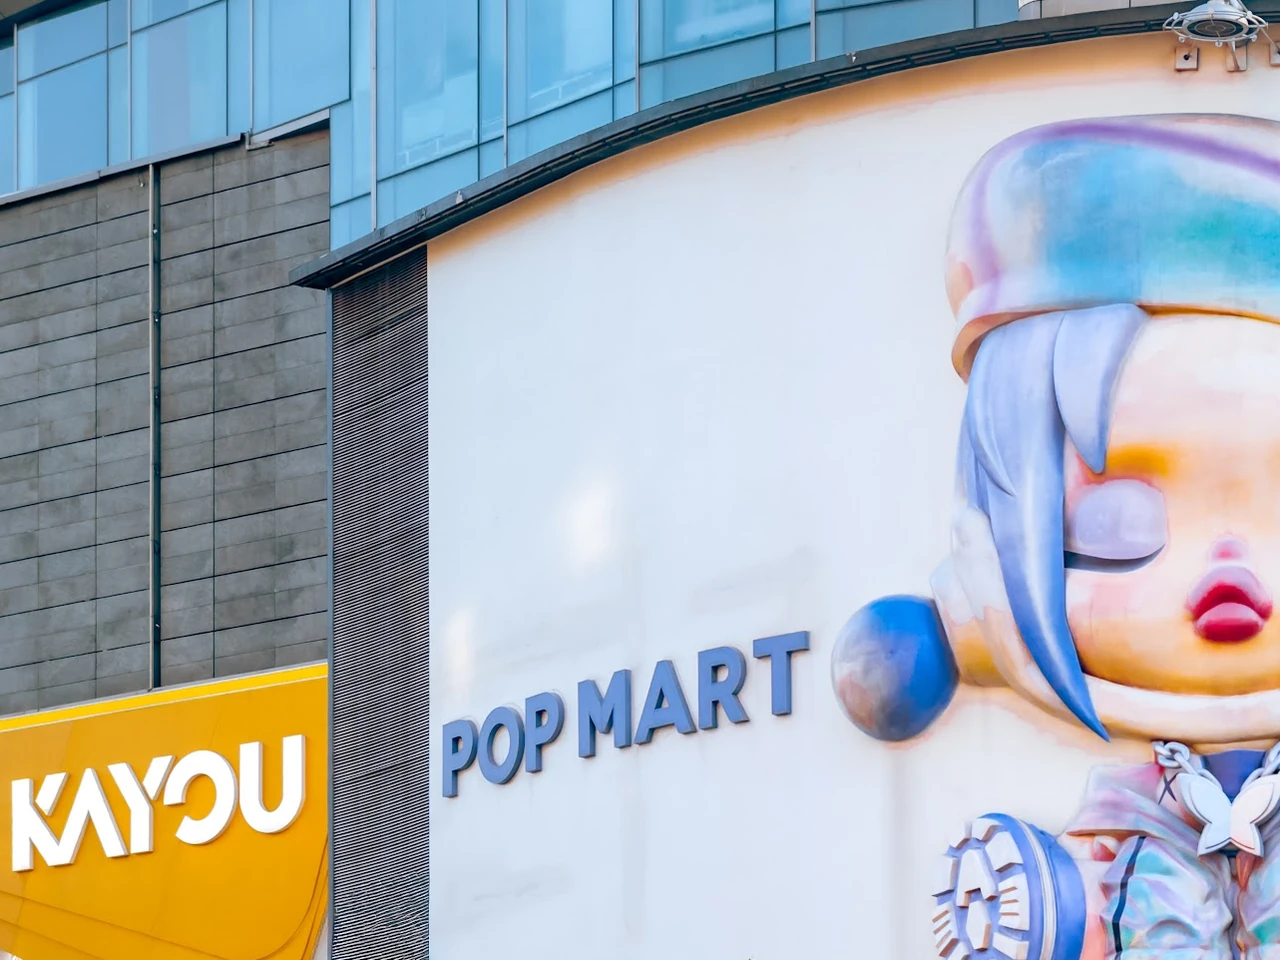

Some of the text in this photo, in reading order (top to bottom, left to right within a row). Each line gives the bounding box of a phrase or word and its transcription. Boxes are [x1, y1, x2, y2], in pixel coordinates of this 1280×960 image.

[442, 630, 810, 798] POP MART
[11, 734, 305, 872] KAYOU
